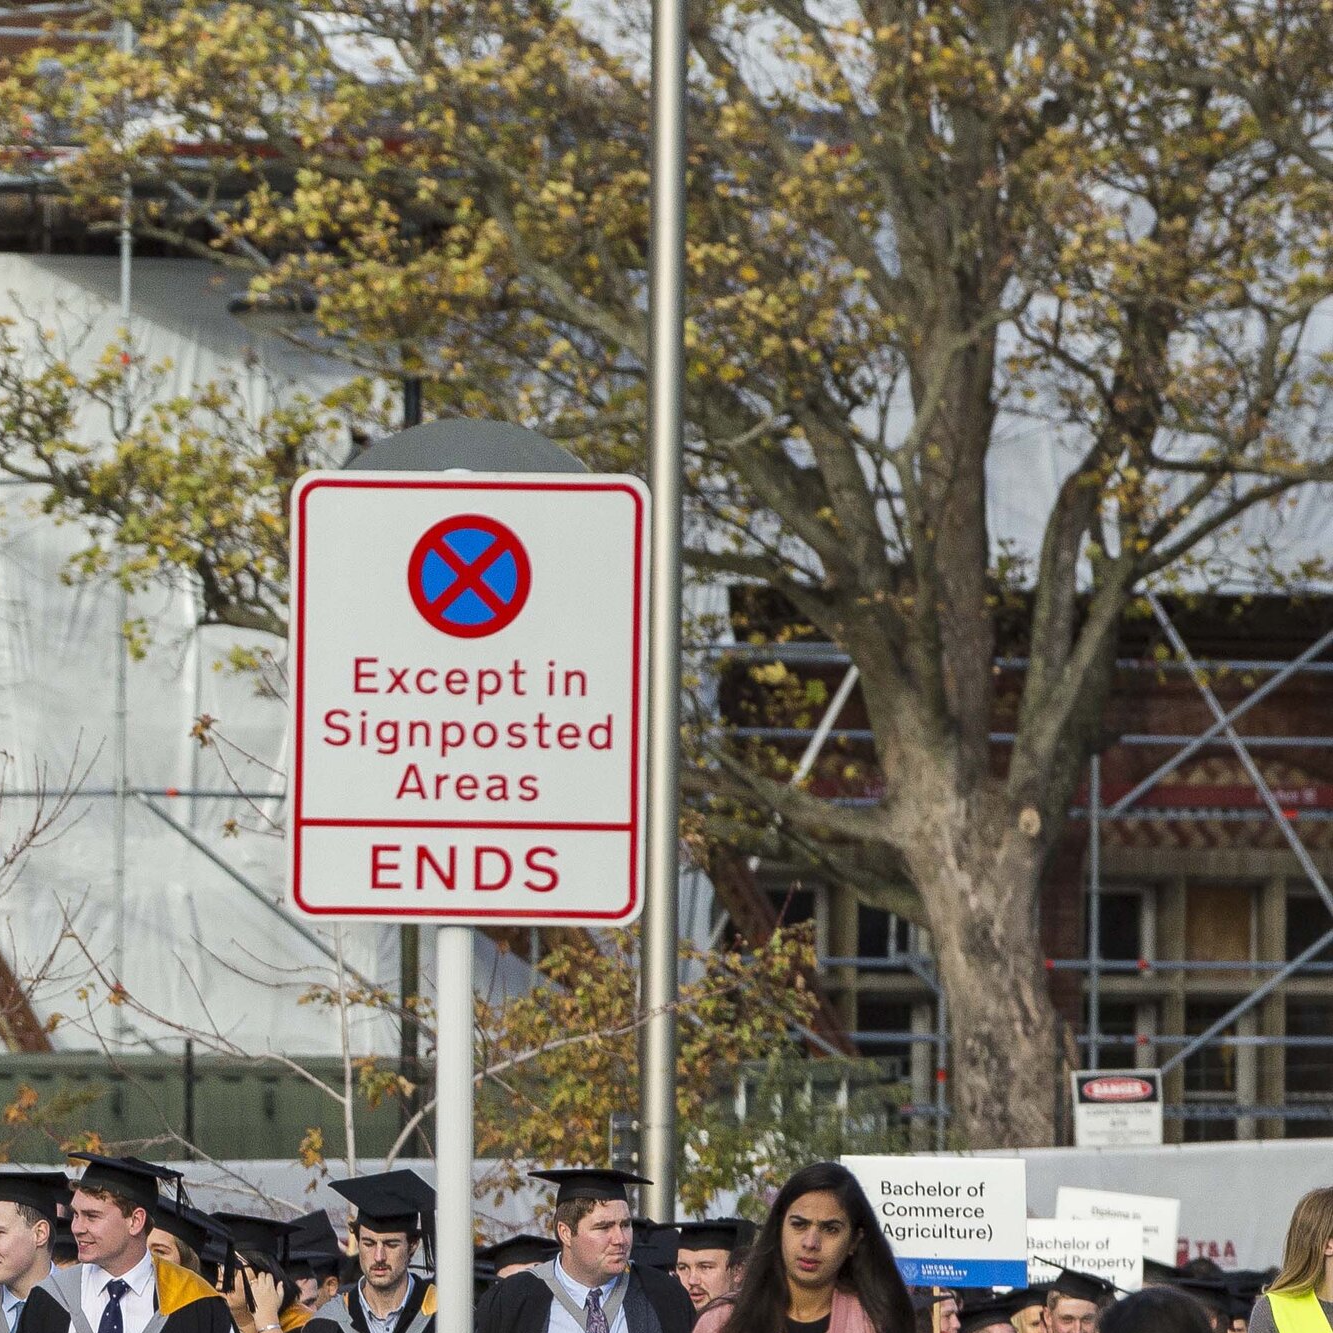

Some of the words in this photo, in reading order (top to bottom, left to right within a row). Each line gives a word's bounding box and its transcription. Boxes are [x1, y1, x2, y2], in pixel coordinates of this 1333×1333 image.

[353, 656, 528, 705] Except
[547, 659, 588, 697] in
[322, 708, 614, 757] Signposted
[395, 763, 540, 802] Areas
[370, 844, 561, 892] ENDS
[881, 1181, 962, 1197] Bachelor
[967, 1182, 986, 1197] of
[882, 1202, 985, 1218] Commerce
[1096, 1237, 1110, 1250] of
[1072, 1256, 1136, 1270] Property
